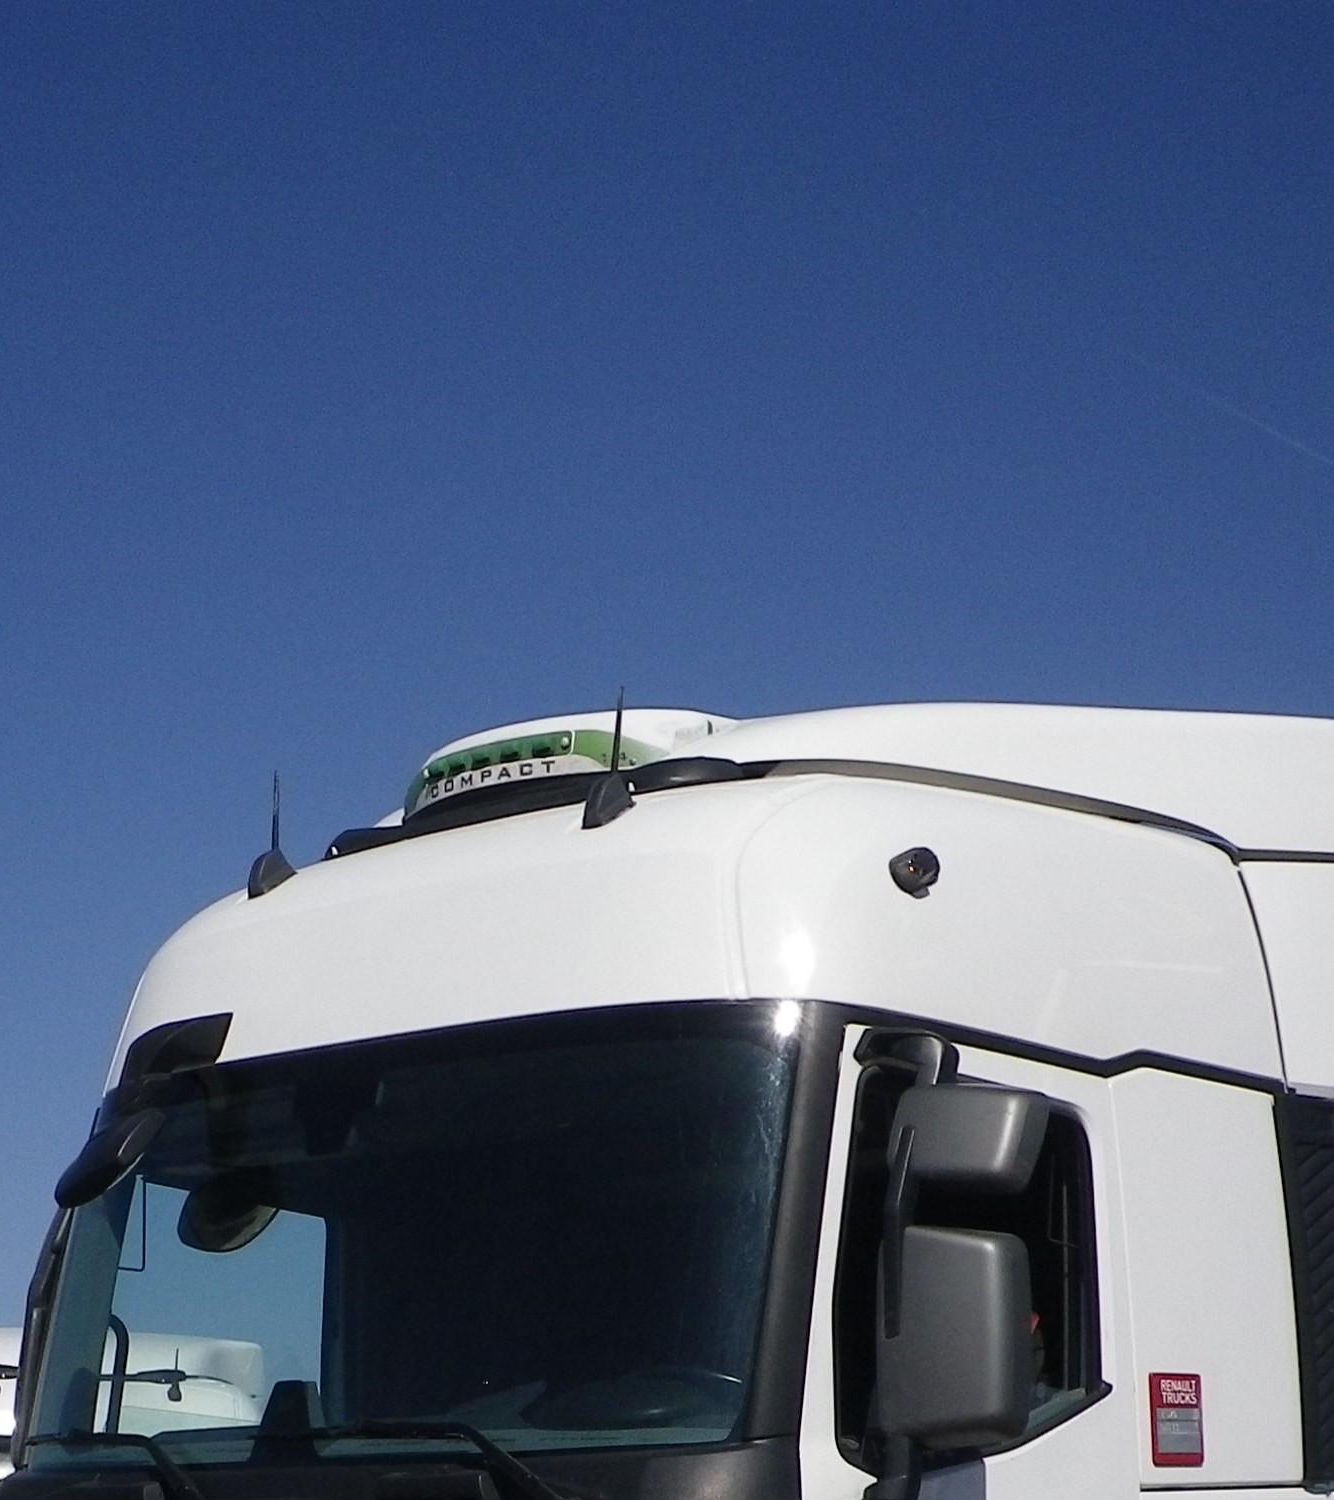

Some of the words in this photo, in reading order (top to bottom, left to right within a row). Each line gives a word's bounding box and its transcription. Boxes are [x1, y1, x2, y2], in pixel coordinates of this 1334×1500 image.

[430, 760, 556, 799] COMPACT
[1160, 1380, 1196, 1392] RENAULT
[1162, 1392, 1197, 1404] TRUCKS
